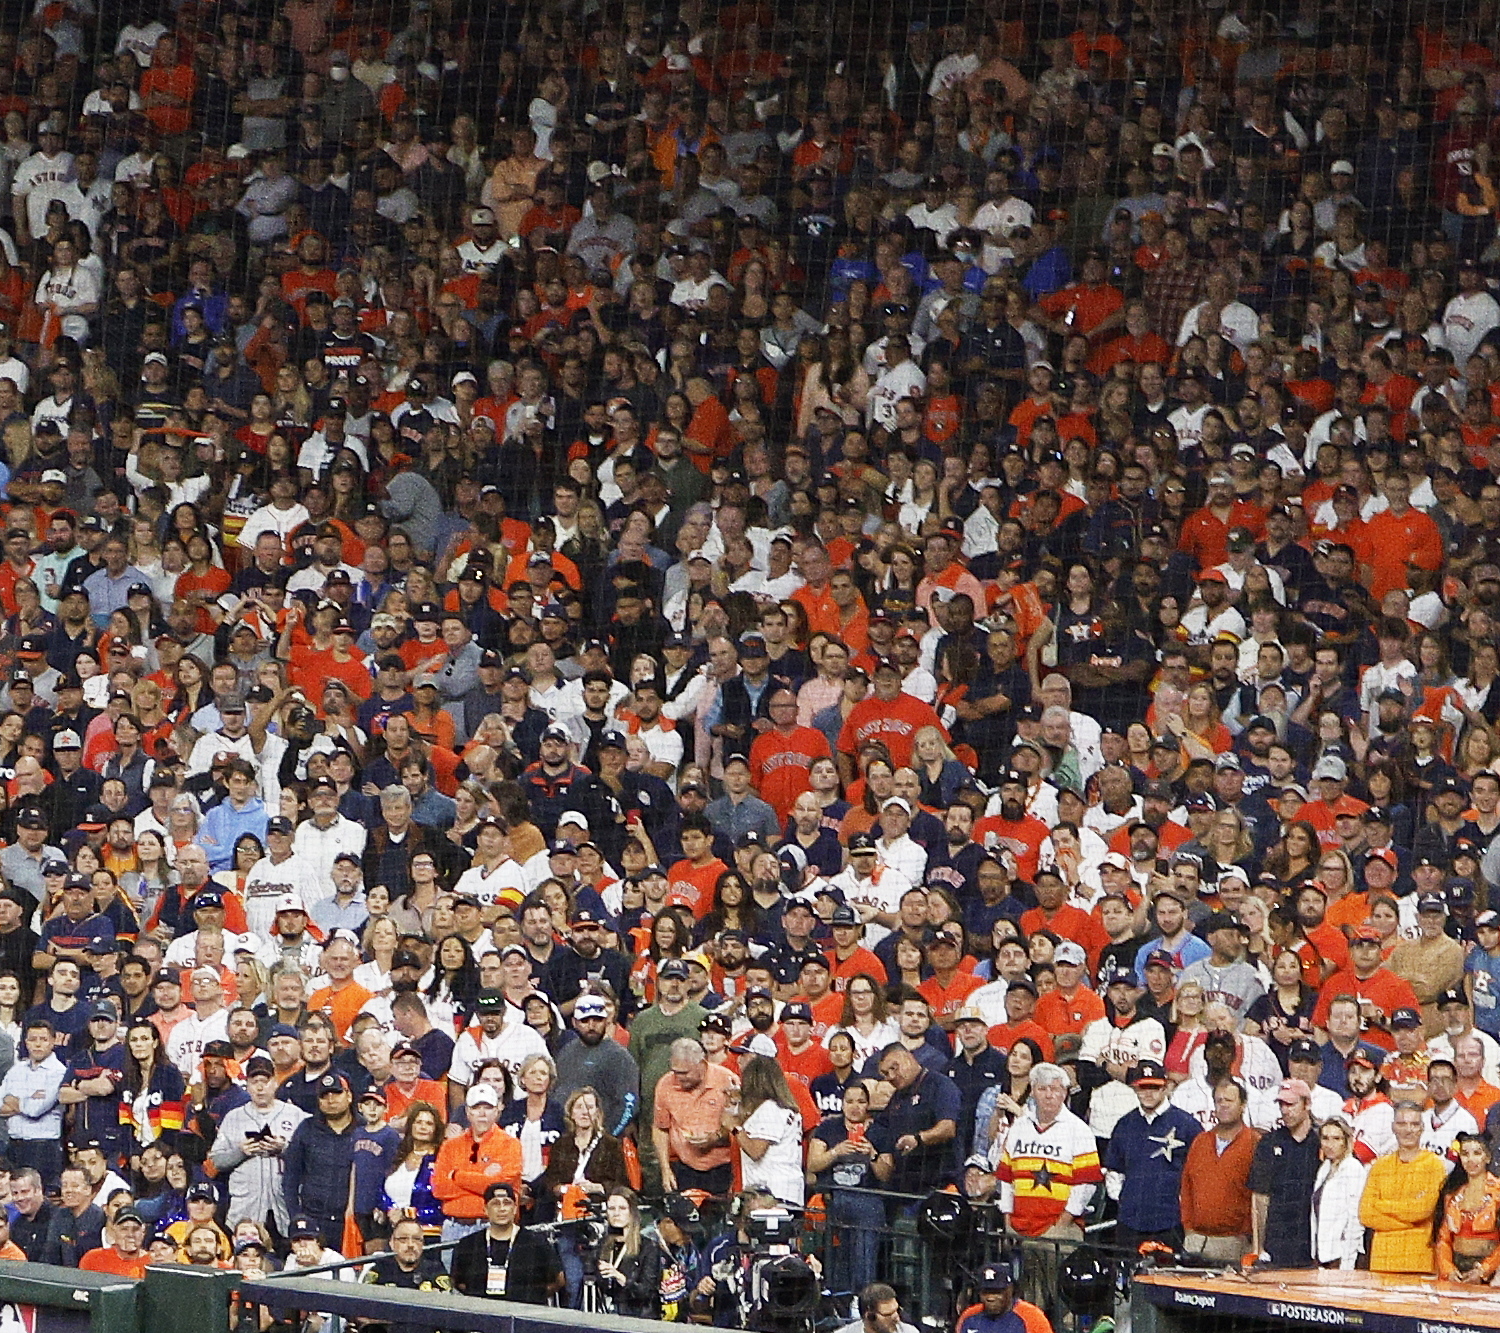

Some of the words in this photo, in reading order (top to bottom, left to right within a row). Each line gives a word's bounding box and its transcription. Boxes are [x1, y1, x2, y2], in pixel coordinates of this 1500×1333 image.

[1012, 1139, 1062, 1157] Astros
[1174, 1291, 1217, 1308] loanDepot
[1279, 1303, 1345, 1325] POSTSEASON
